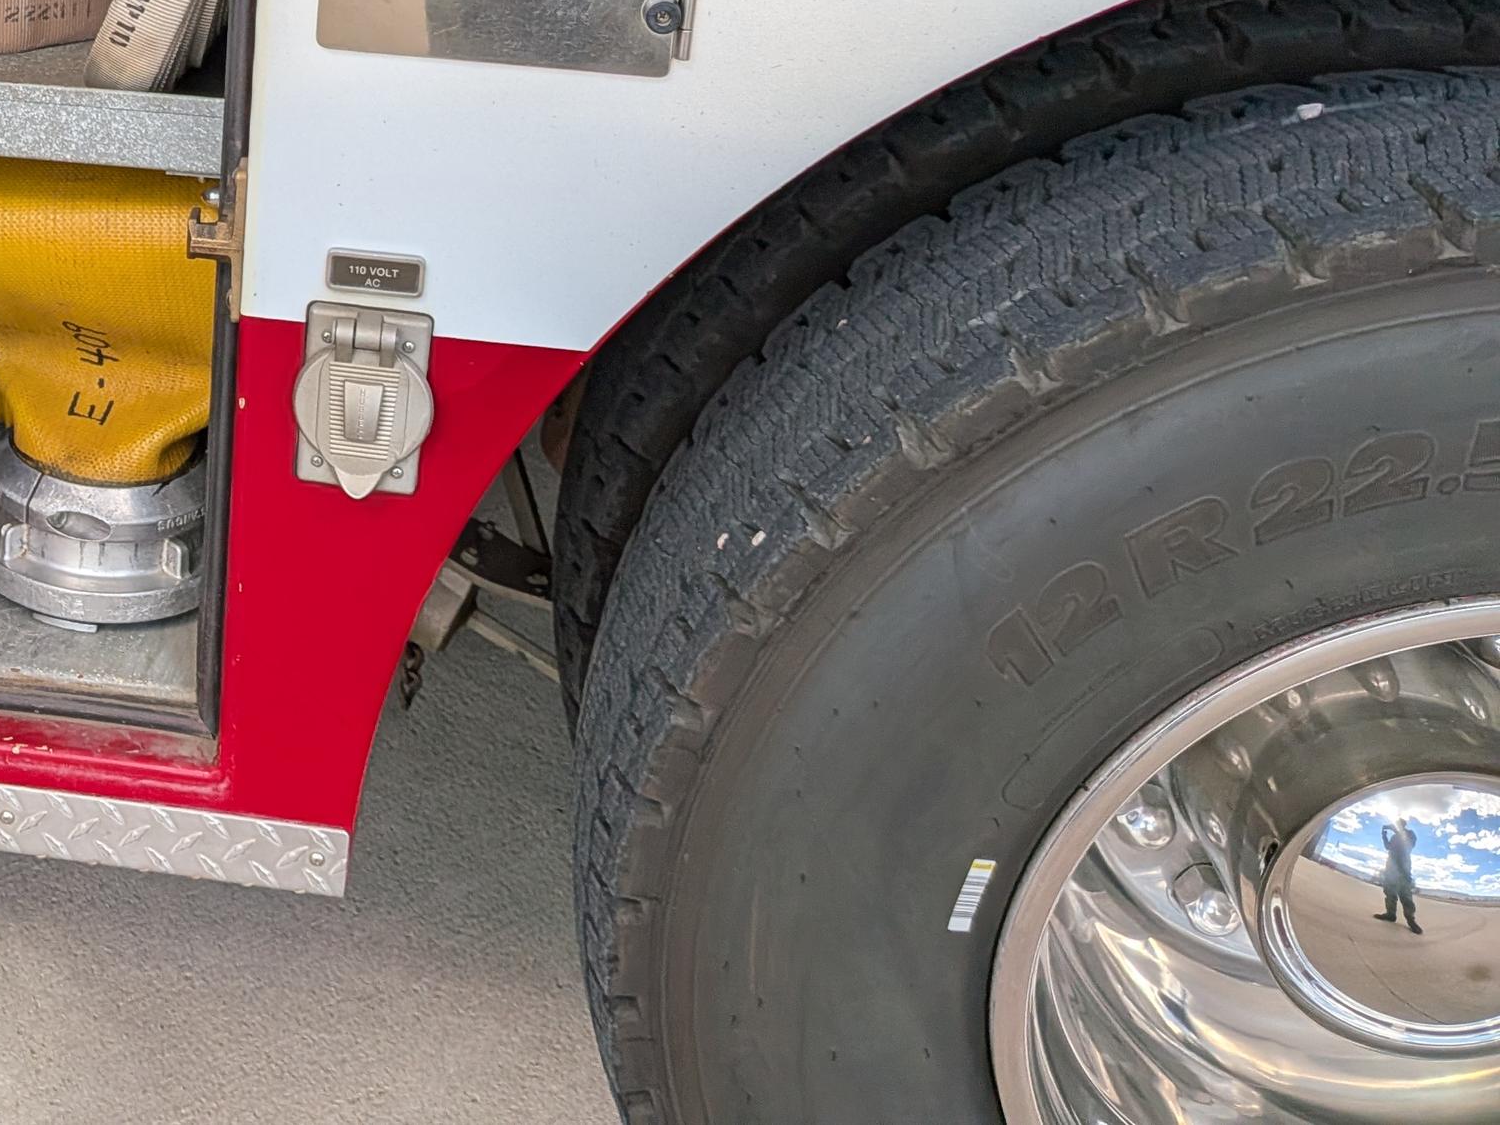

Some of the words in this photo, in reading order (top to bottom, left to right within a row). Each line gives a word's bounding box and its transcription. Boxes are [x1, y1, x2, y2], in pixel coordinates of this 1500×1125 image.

[349, 265, 367, 275] 110
[370, 266, 399, 278] VOLT
[364, 278, 381, 288] AC
